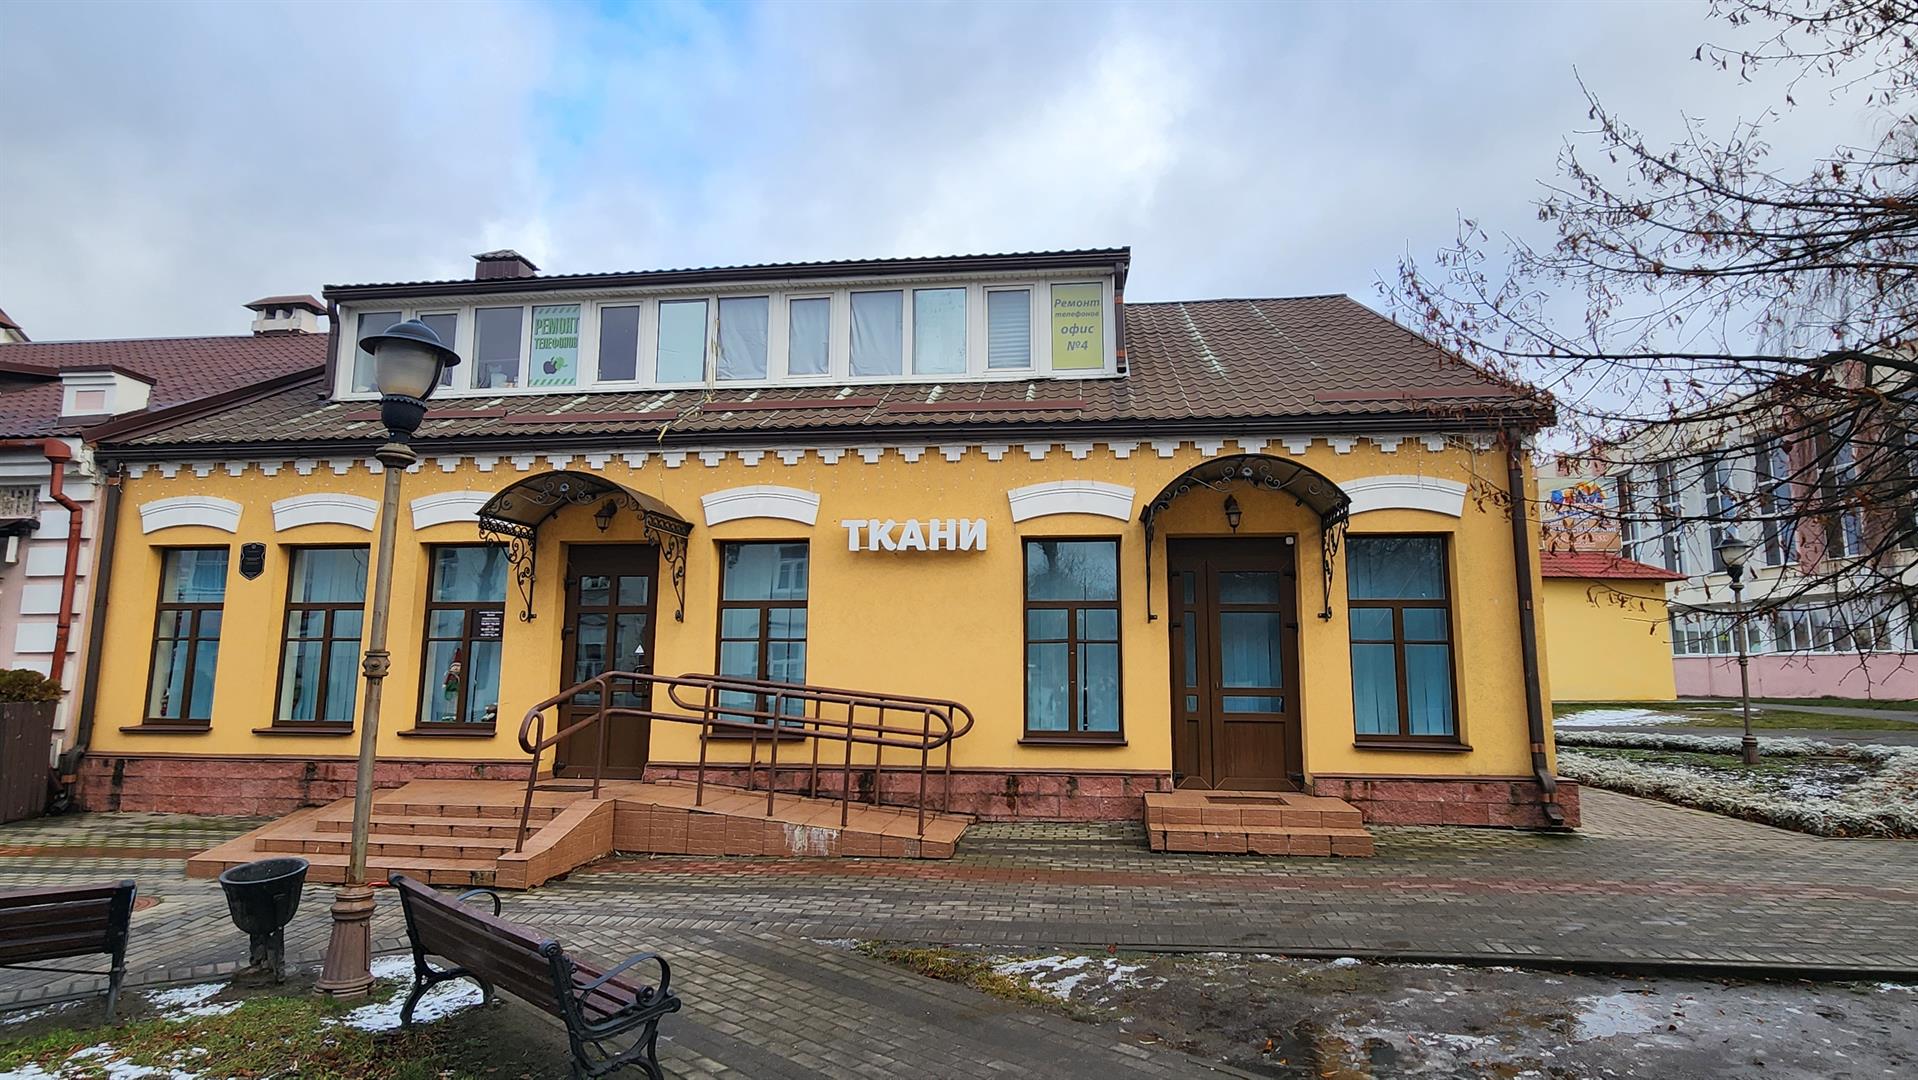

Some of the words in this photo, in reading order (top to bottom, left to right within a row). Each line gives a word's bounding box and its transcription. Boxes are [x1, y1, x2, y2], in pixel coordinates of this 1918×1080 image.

[1054, 299, 1100, 308] Ремонт
[535, 317, 580, 335] РЕМОНТ
[1061, 323, 1095, 337] офис
[1067, 341, 1088, 351] №4
[841, 519, 988, 551] ТКАНИ
